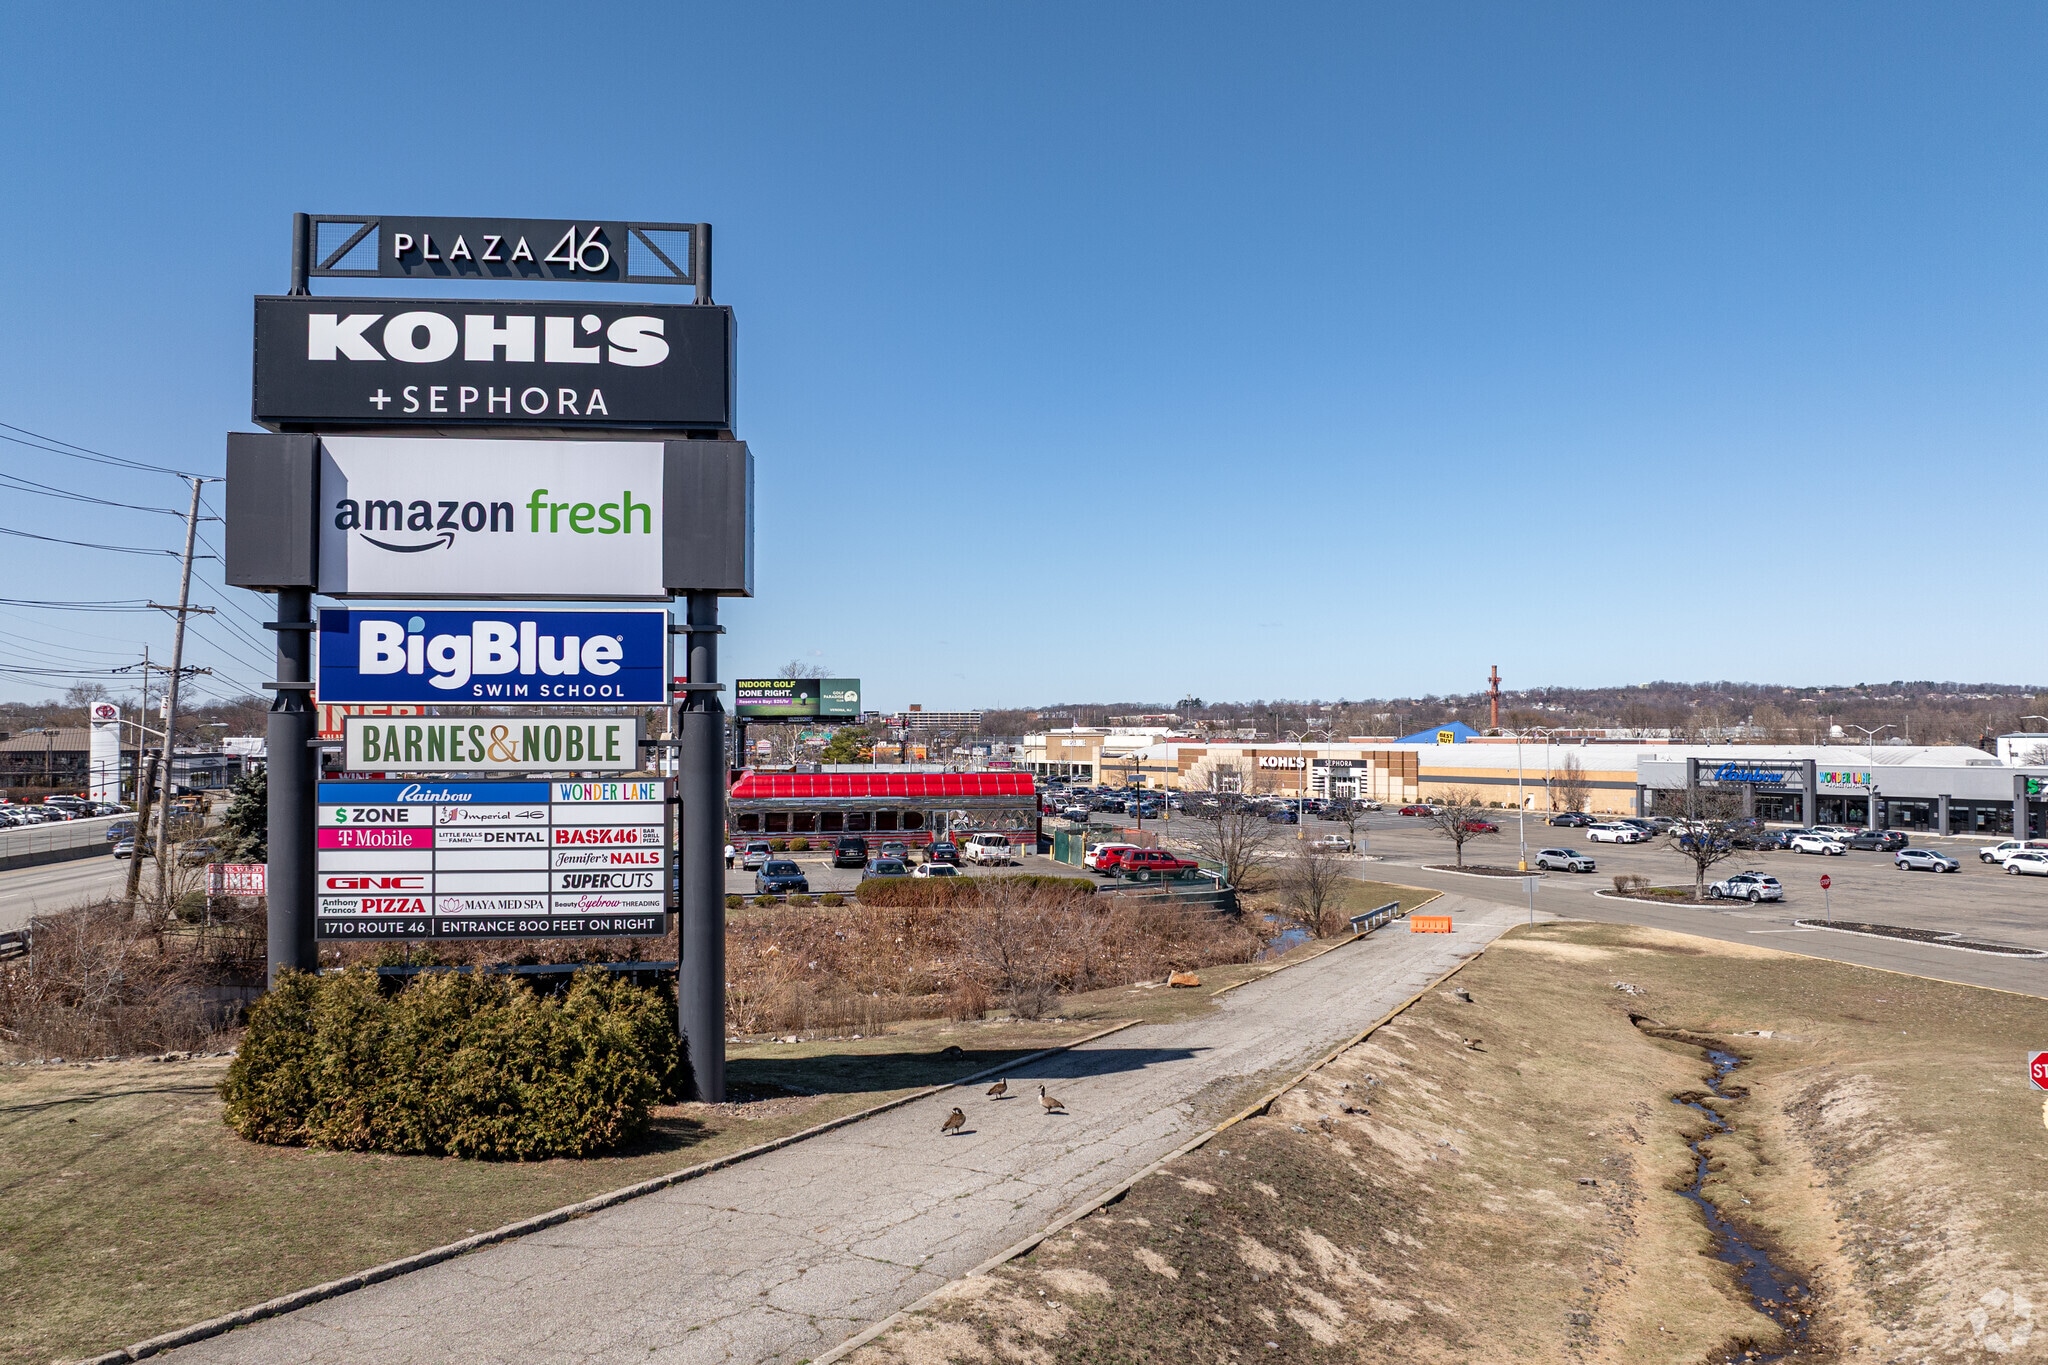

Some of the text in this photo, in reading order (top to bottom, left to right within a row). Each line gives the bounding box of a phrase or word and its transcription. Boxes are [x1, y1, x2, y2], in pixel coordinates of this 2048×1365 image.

[395, 225, 609, 273] PLAZA 46
[308, 311, 670, 367] KOHL'S
[334, 488, 651, 534] amazon fresh
[473, 684, 624, 697] SWIM SCHOOL
[1260, 756, 1306, 767] KOHL'S
[1714, 762, 1784, 782] Rainbow
[1819, 771, 1851, 783] WONDER
[396, 783, 472, 802] Rainbow
[560, 783, 656, 800] WONDER LANE
[352, 808, 409, 822] ZONE
[458, 809, 511, 822] Imperial
[515, 810, 545, 819] 46
[484, 832, 545, 843] DENTAL
[555, 852, 660, 867] Jennifer's NAILS
[326, 877, 424, 889] GNC
[322, 899, 358, 908] Anthony
[361, 898, 426, 913] PIZZA
[465, 899, 544, 910] MAYA MED SPA
[577, 895, 622, 913] Eyebrow
[324, 922, 425, 933] 1710 ROUTE 46
[442, 919, 655, 932] ENTRANCE 800 FEET ON RIGHT
